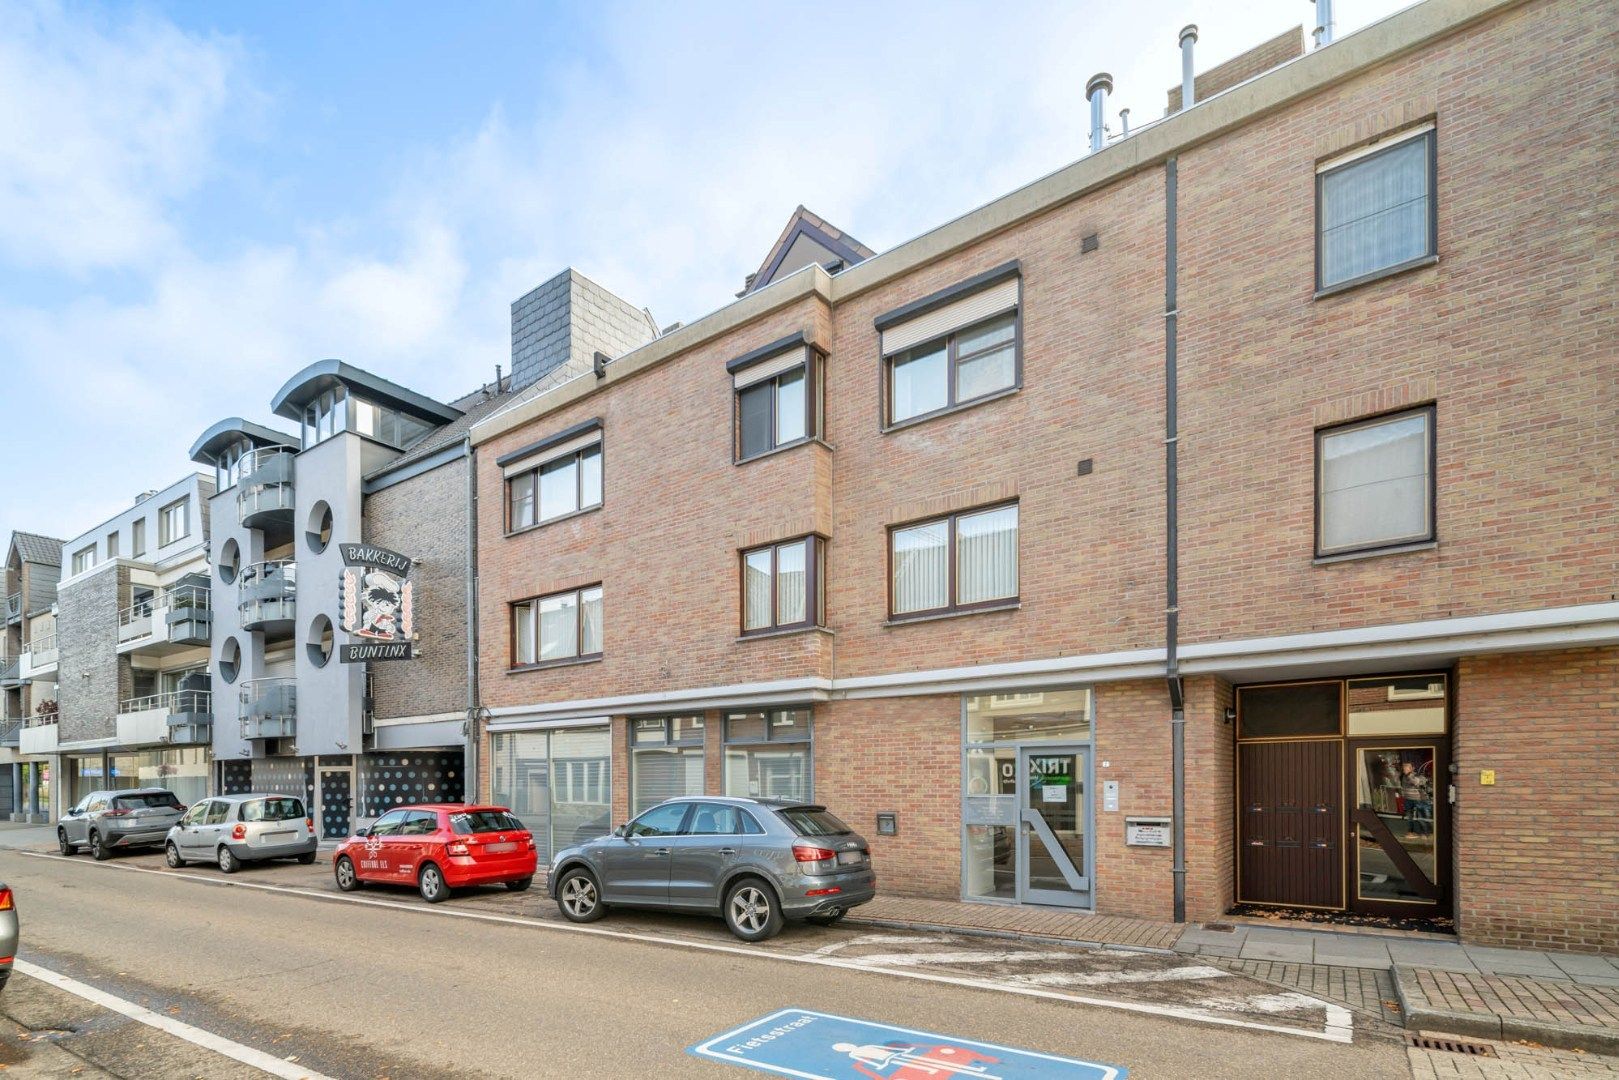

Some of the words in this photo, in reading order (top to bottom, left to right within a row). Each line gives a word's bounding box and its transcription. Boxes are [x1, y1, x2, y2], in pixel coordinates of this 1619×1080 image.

[348, 547, 407, 570] BAKKERIJ
[349, 645, 407, 660] BUNTINX
[726, 1015, 818, 1055] Fietsstraat
